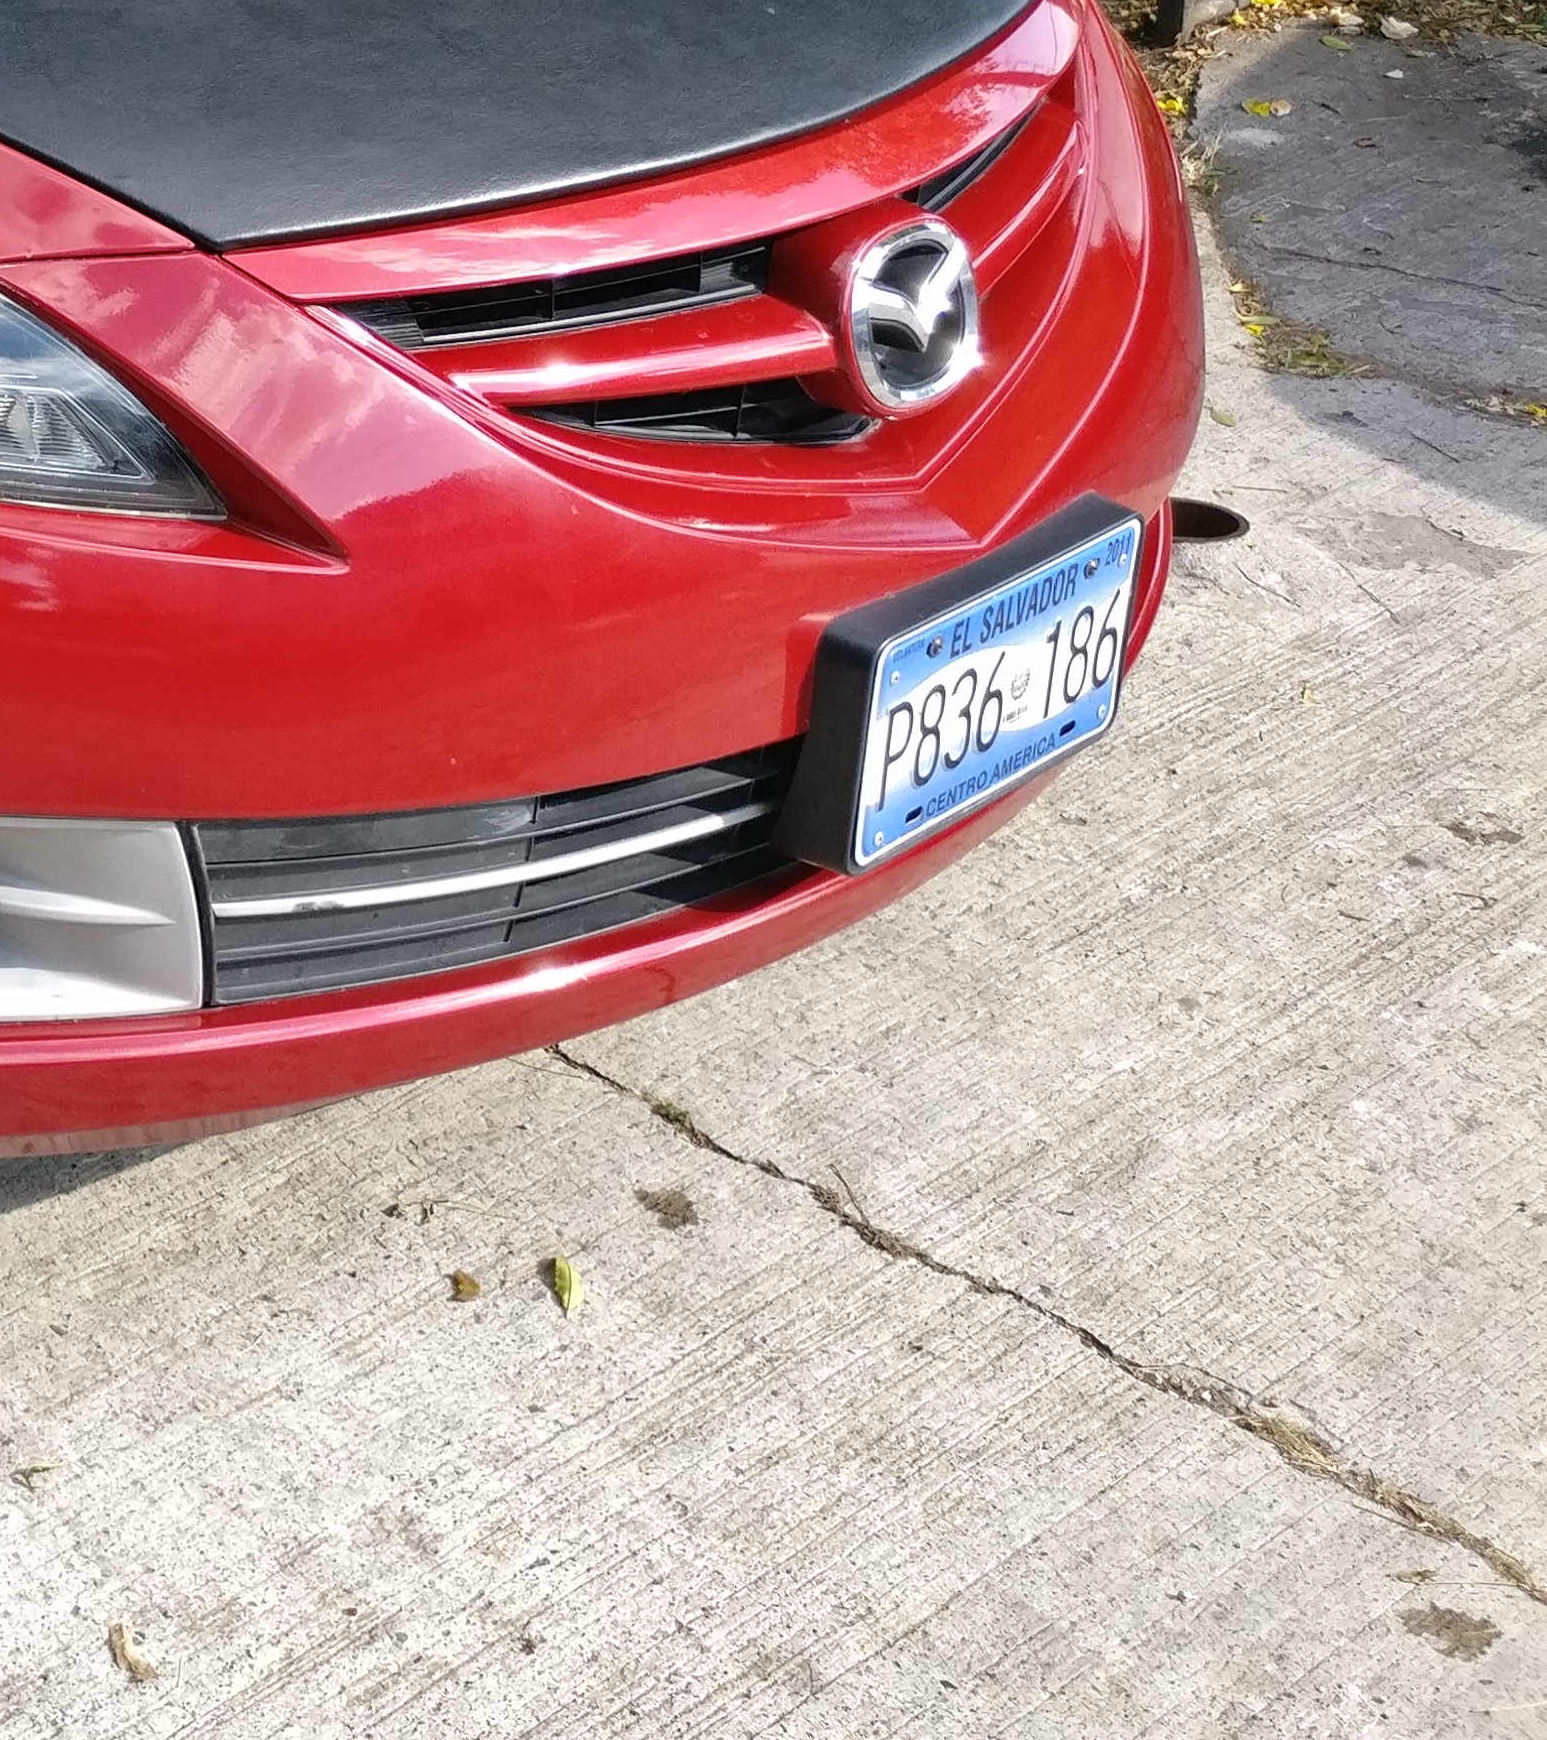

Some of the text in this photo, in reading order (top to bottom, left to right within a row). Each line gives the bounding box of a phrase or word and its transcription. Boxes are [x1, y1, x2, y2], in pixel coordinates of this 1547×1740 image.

[949, 562, 1079, 659] EL SALVADOR
[877, 588, 1121, 813] P836 186
[925, 735, 1056, 817] CENTRO AMERICA
